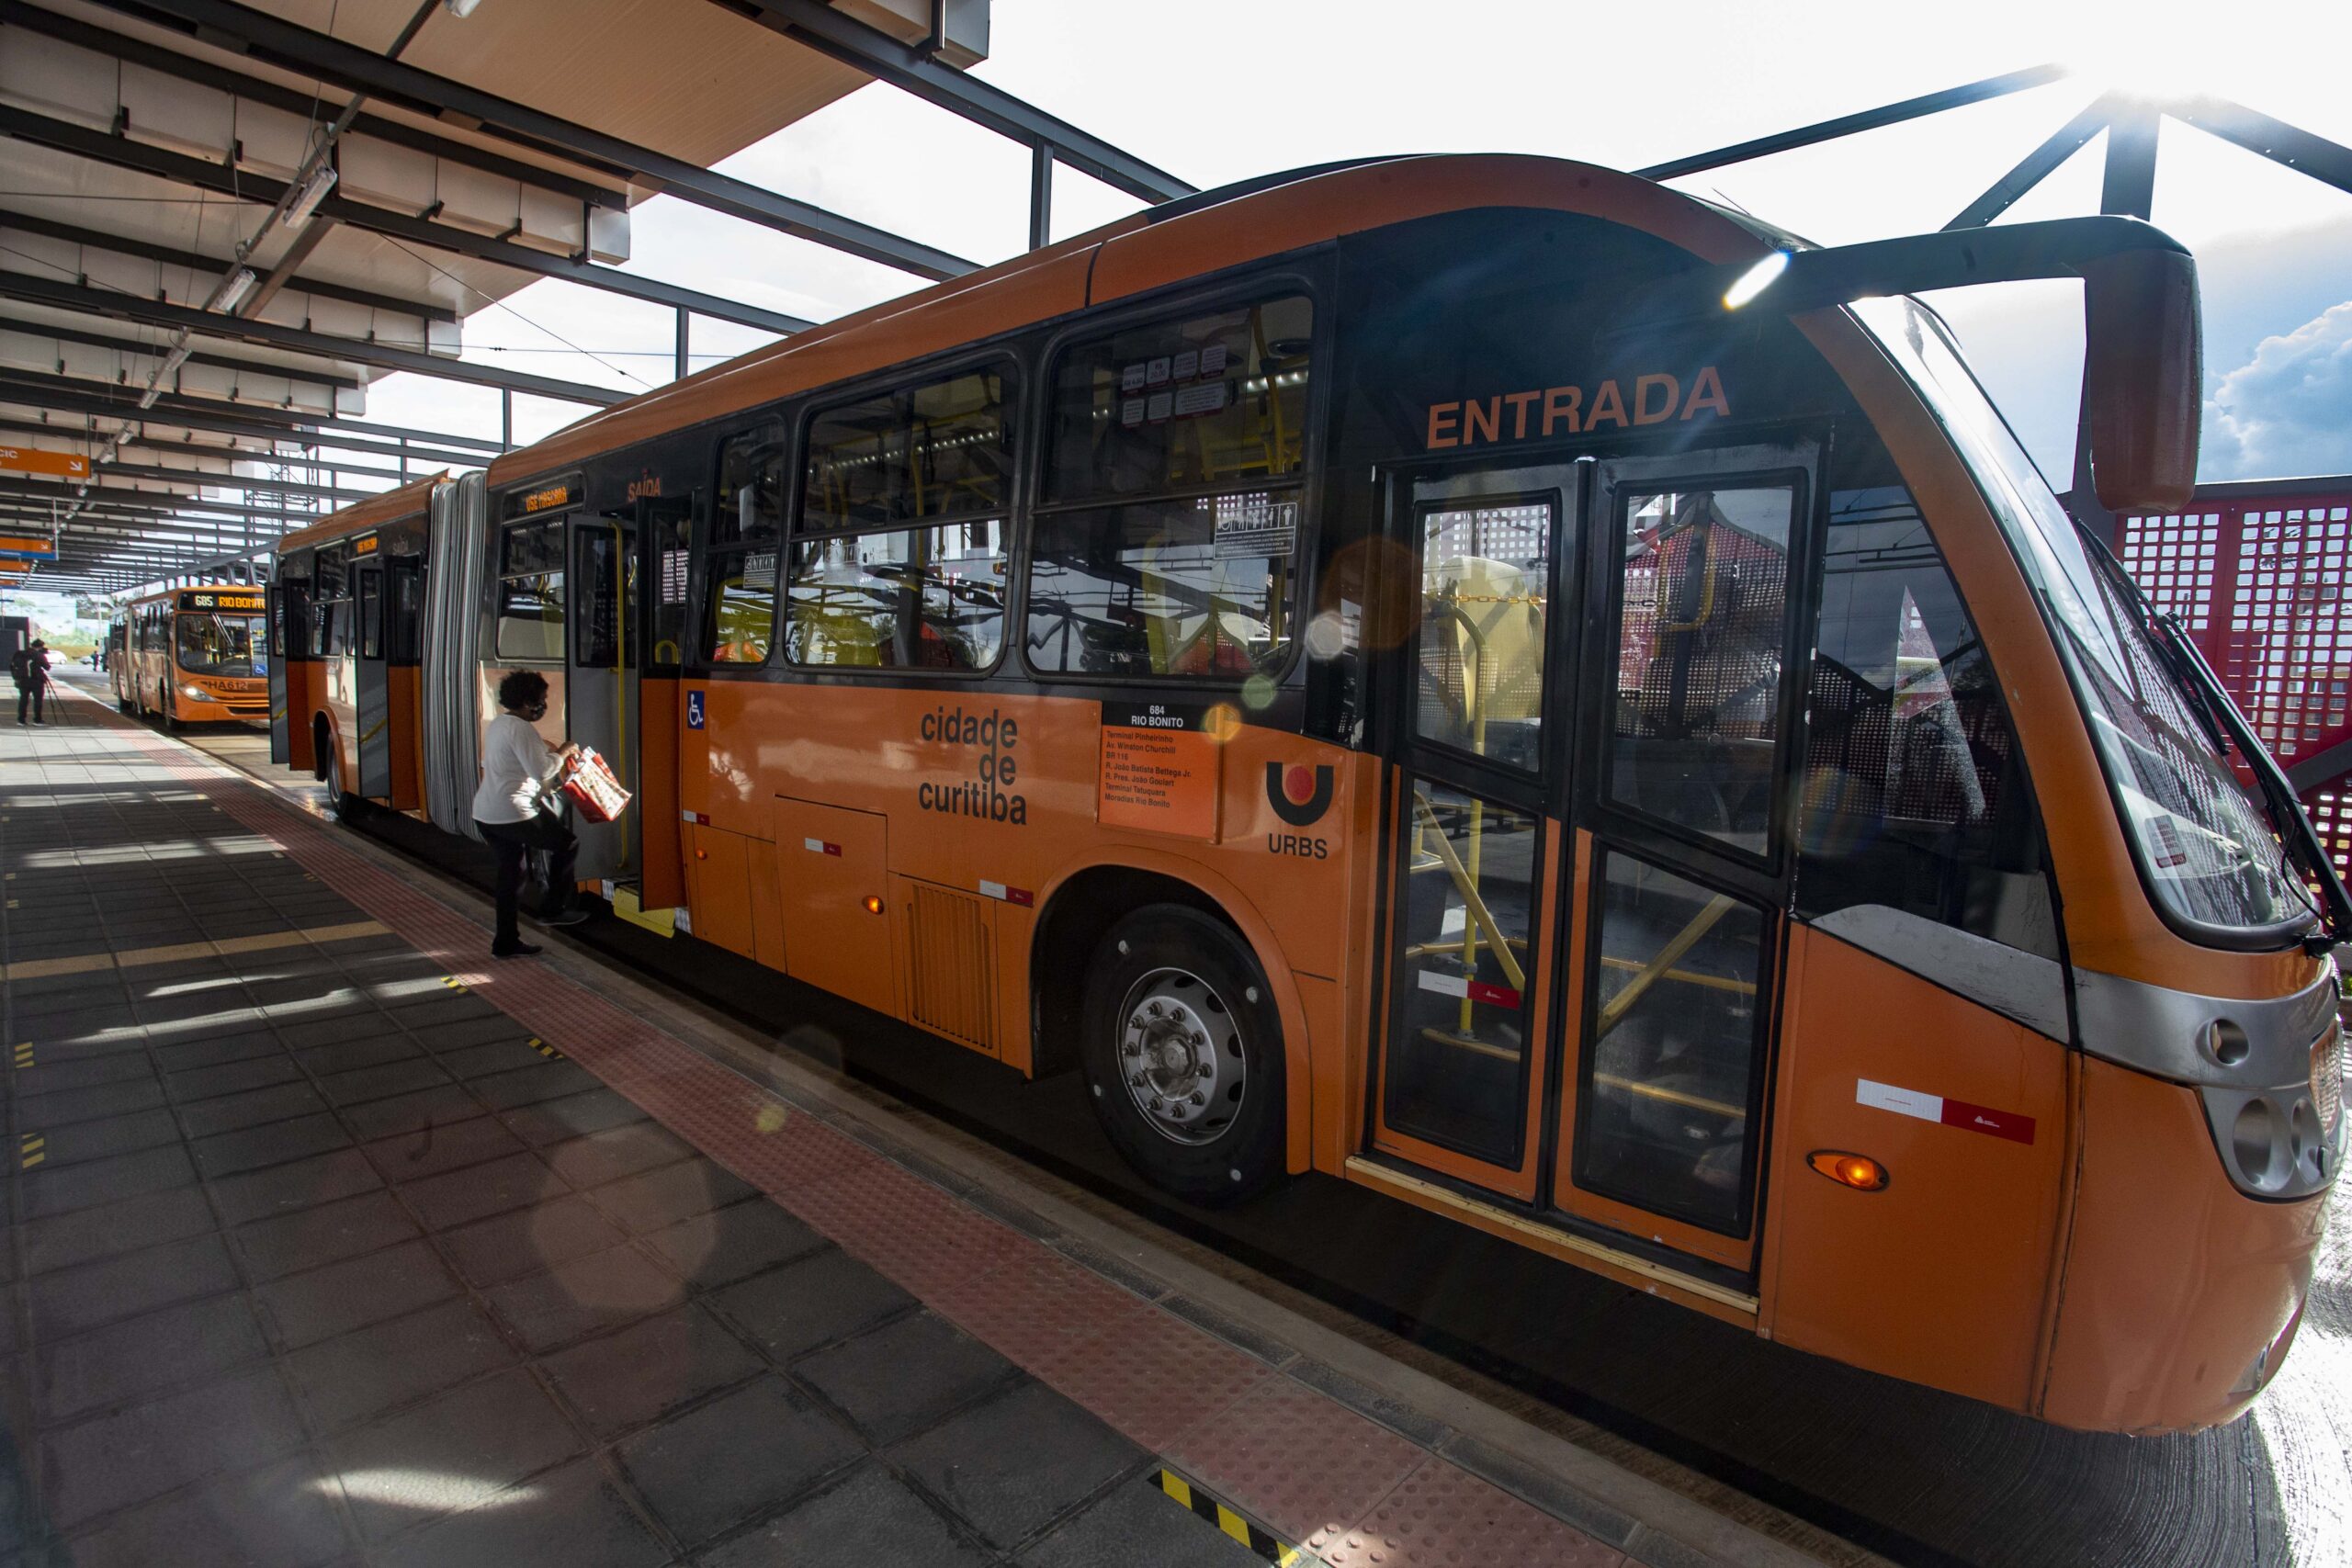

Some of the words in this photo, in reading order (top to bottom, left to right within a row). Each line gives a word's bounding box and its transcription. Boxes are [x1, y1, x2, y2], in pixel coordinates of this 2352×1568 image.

[1427, 367, 1731, 449] ENTRADA
[219, 596, 234, 607] RIO
[1149, 705, 1165, 715] 684
[921, 705, 1018, 749] cidade
[1131, 716, 1147, 726] RIO
[1148, 716, 1183, 728] BONITO
[1107, 731, 1133, 739] Terminal
[1135, 733, 1173, 743] Pinheirinho
[1117, 743, 1144, 751] Winston
[1145, 745, 1176, 754] Churchill
[979, 750, 1016, 786] de
[1114, 762, 1129, 771] João
[1131, 764, 1154, 774] Batista
[1132, 774, 1148, 784] João
[1149, 777, 1174, 786] Goulart
[1105, 783, 1132, 792] Terminal
[1134, 785, 1166, 796] Tatuquara
[919, 781, 1027, 826] curitiba
[1104, 793, 1134, 802] Moradias
[1136, 796, 1147, 806] Rio
[1148, 798, 1170, 808] Bonito
[1269, 832, 1328, 860] URBS
